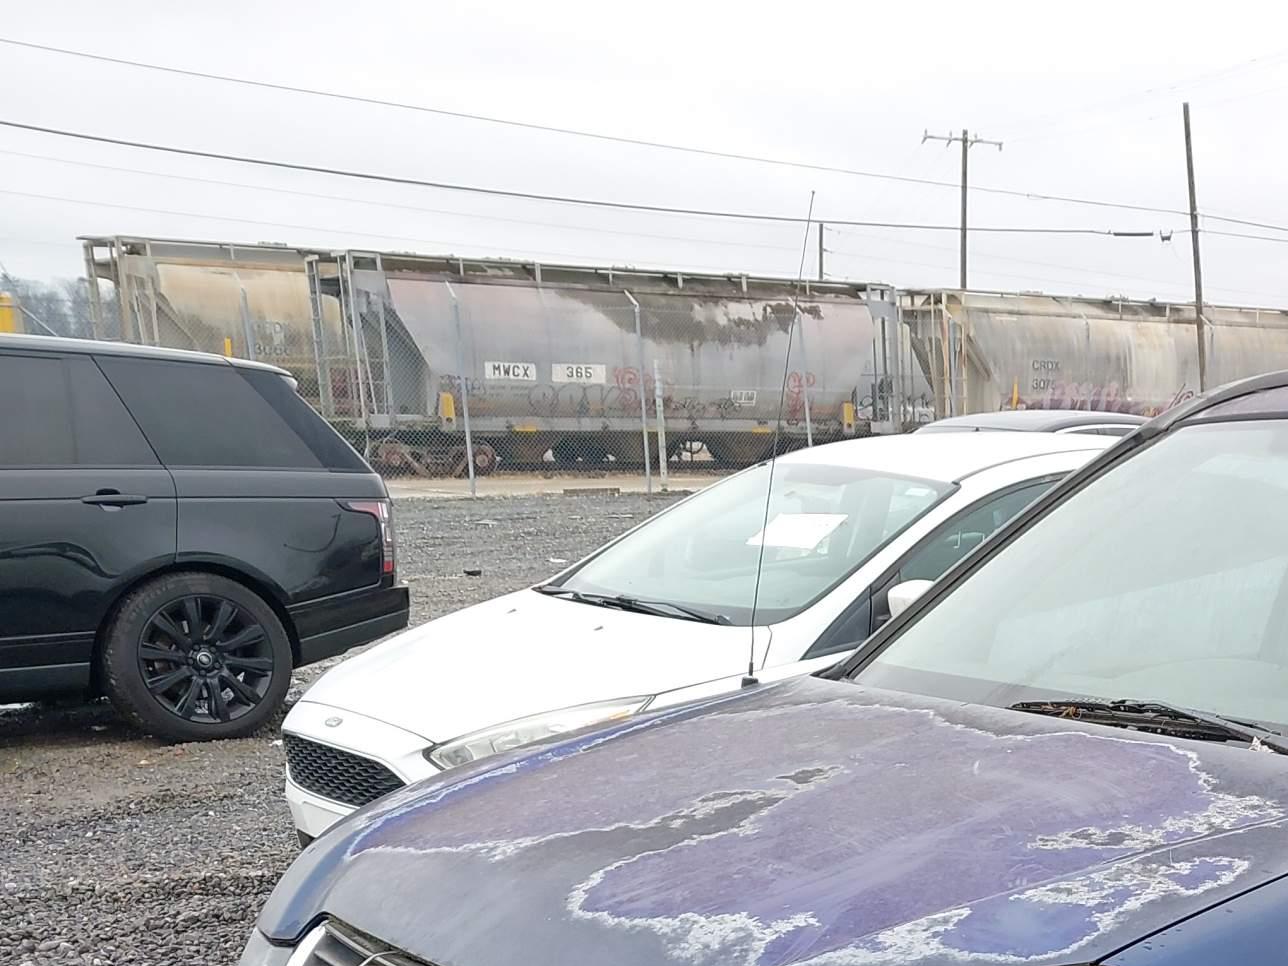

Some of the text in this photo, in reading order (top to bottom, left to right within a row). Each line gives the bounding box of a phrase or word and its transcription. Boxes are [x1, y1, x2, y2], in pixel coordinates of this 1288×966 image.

[492, 364, 593, 378] MWCX 365
[1031, 360, 1060, 371] CRDX
